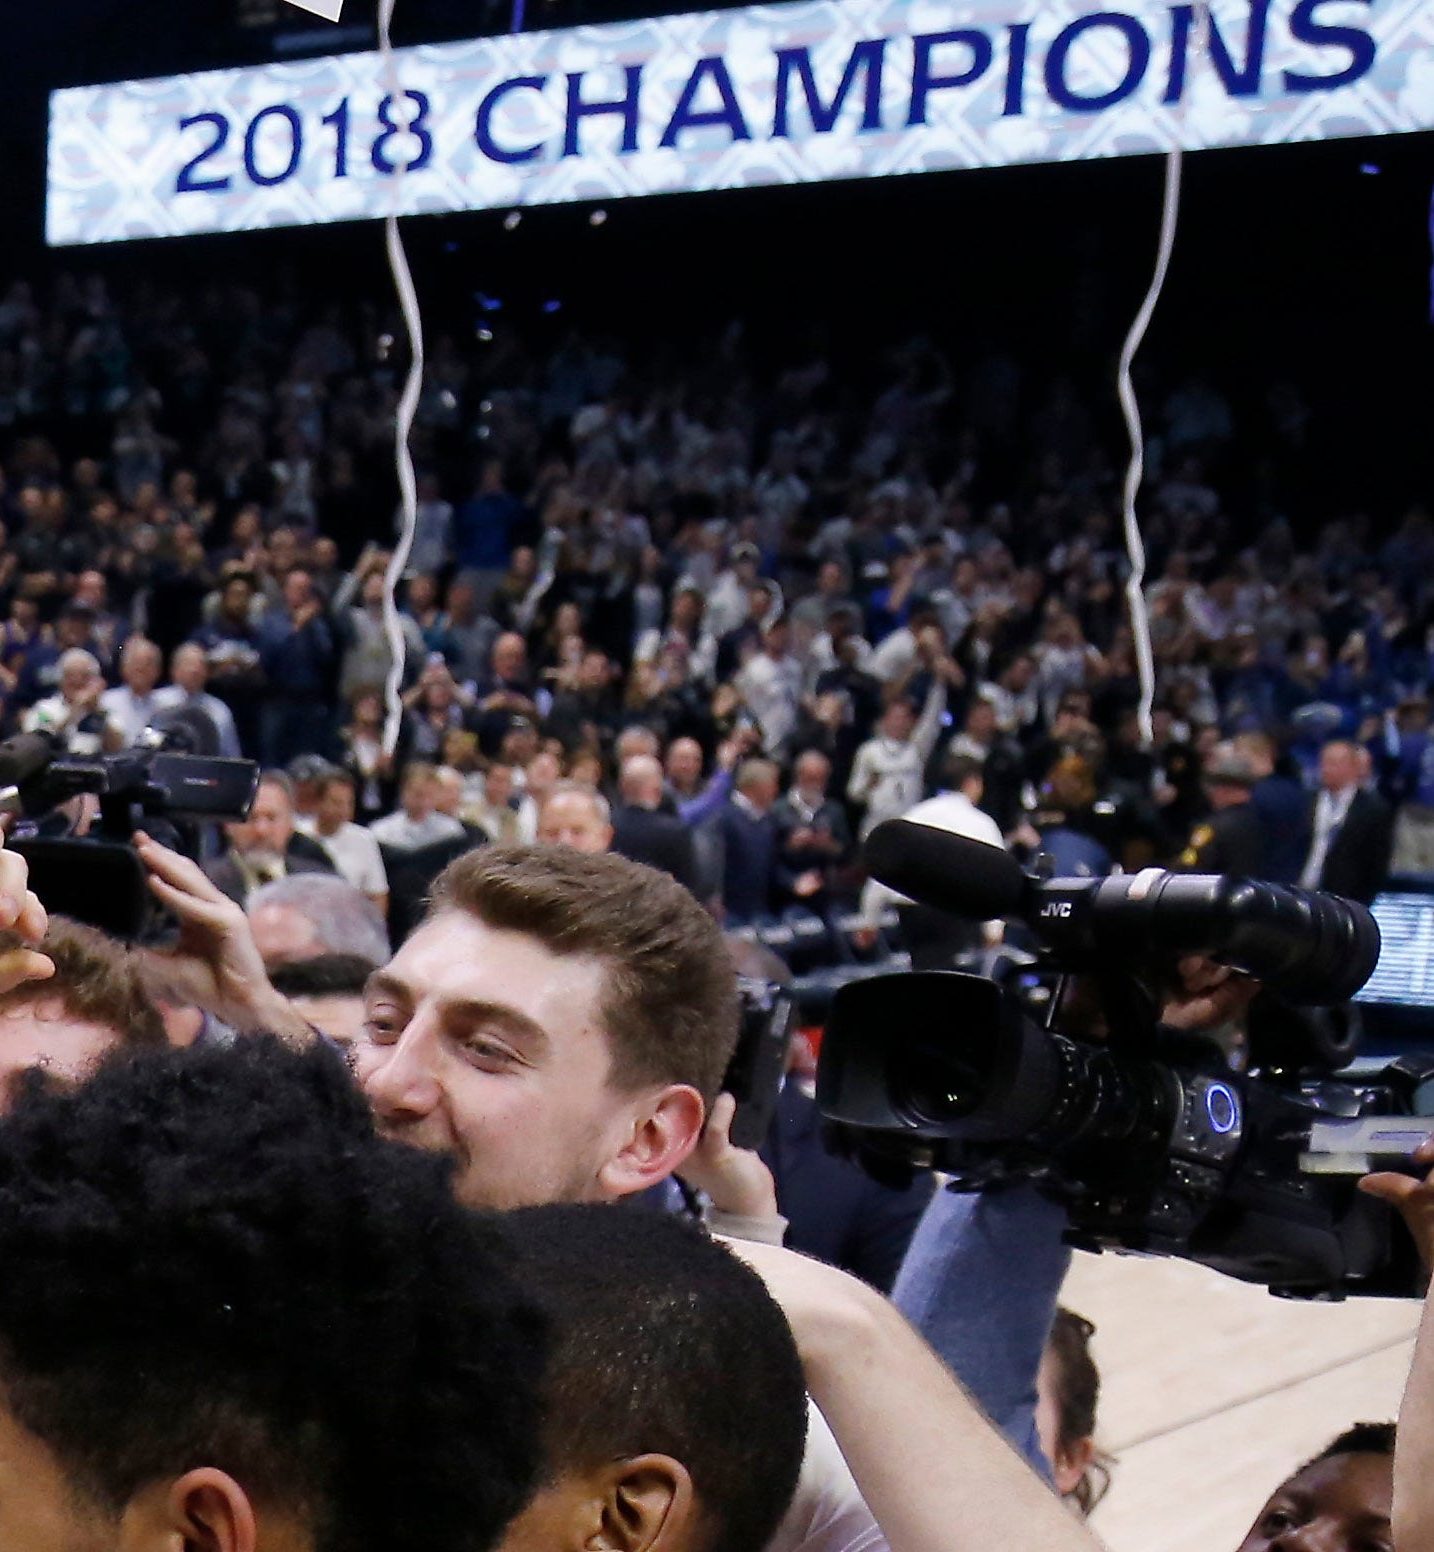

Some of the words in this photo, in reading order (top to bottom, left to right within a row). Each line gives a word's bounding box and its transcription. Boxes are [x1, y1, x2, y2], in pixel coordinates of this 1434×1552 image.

[176, 89, 432, 192] 2018
[475, 0, 1376, 164] CHAMPIONS
[1040, 902, 1072, 918] JVC
